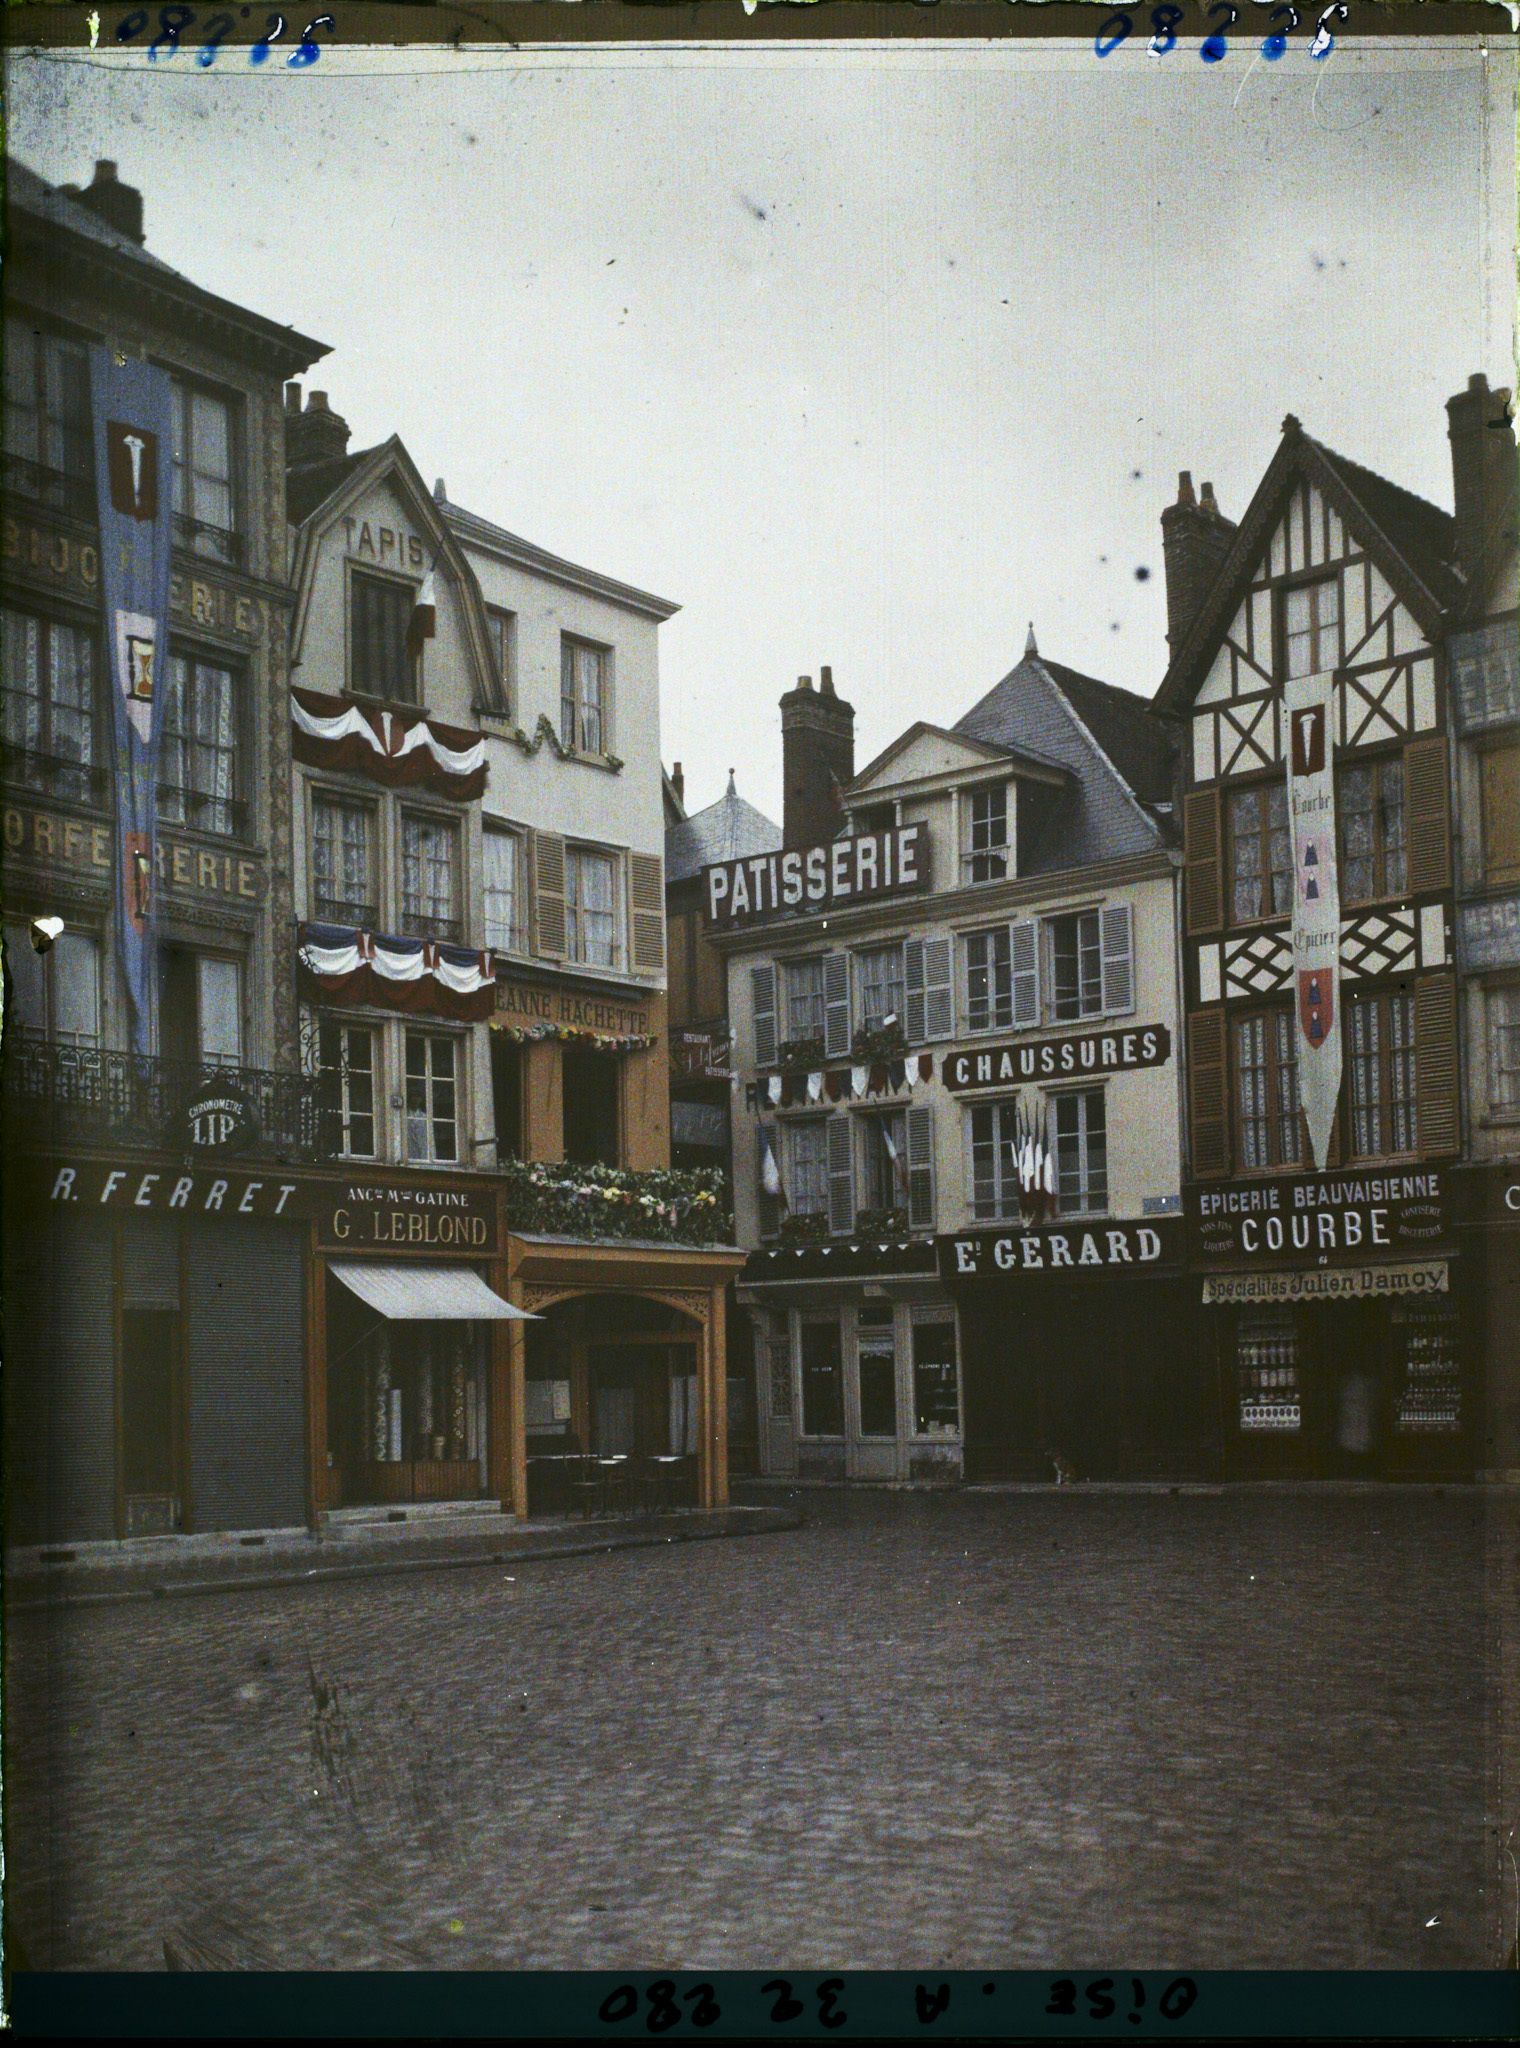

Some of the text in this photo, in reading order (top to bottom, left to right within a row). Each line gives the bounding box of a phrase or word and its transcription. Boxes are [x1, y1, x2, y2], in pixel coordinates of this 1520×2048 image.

[342, 516, 423, 566] TAPIS
[2, 517, 253, 634] BIJOERIE
[4, 809, 257, 897] ORFERERIE
[709, 827, 918, 920] PATISSERIE
[560, 997, 647, 1034] HACHETTE
[956, 1031, 1158, 1084] CHAUSSURES
[50, 1167, 296, 1215] R. FERRET
[415, 1191, 470, 1207] GATINE
[1293, 1174, 1440, 1208] BEAUVAISIENNE
[373, 1210, 487, 1246] LEBLOND
[1241, 1208, 1391, 1253] COURBE
[1290, 1272, 1355, 1294] Julien
[1360, 1269, 1444, 1291] Damoy
